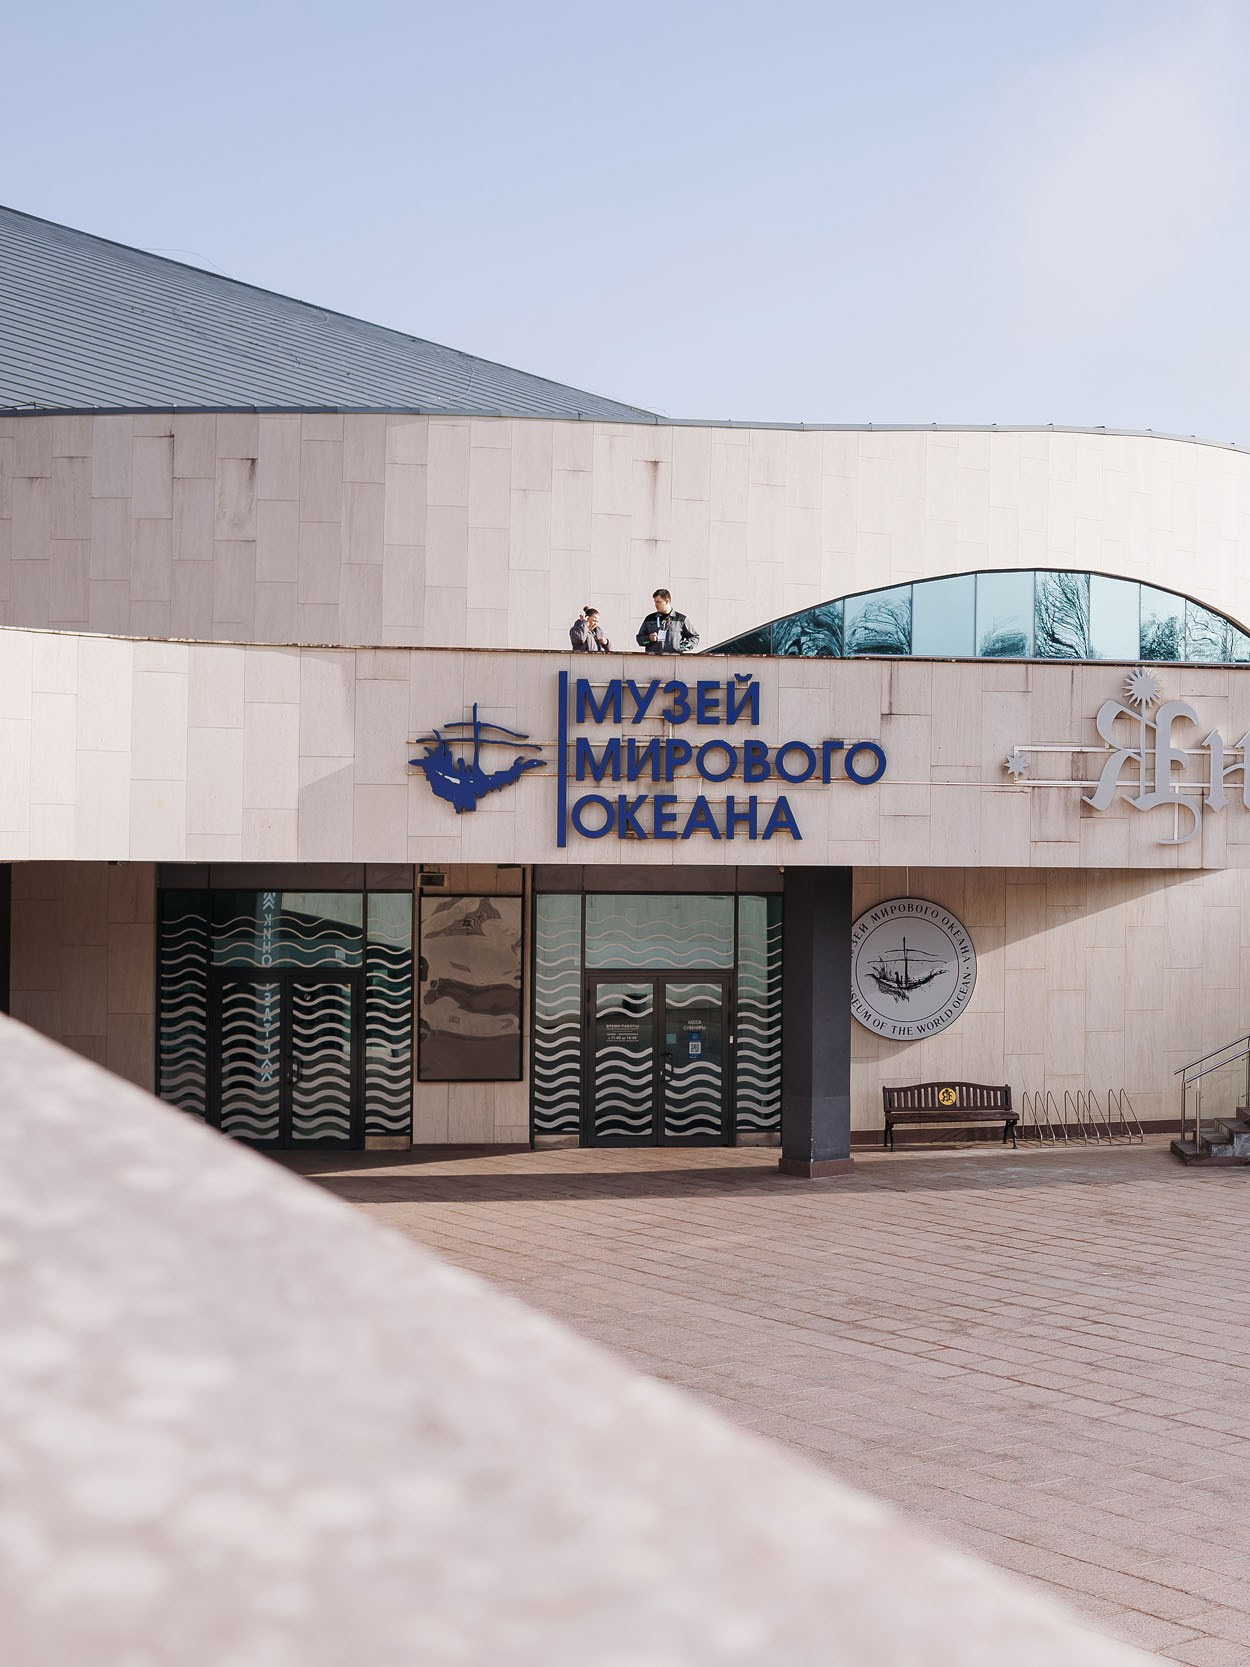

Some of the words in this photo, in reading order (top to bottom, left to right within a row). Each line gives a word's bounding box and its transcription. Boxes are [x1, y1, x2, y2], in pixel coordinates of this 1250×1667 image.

[576, 673, 760, 725] МУЗЕЙ
[576, 738, 886, 785] МИРОВОГО
[572, 794, 802, 840] ОКЕАНА
[870, 903, 939, 924] МИРОВОГО
[941, 916, 971, 963] ОКЕАНА
[872, 1018, 888, 1030] OF
[891, 1025, 913, 1036] THE
[916, 1009, 953, 1034] WORLD
[952, 972, 971, 1009] OCEAN
